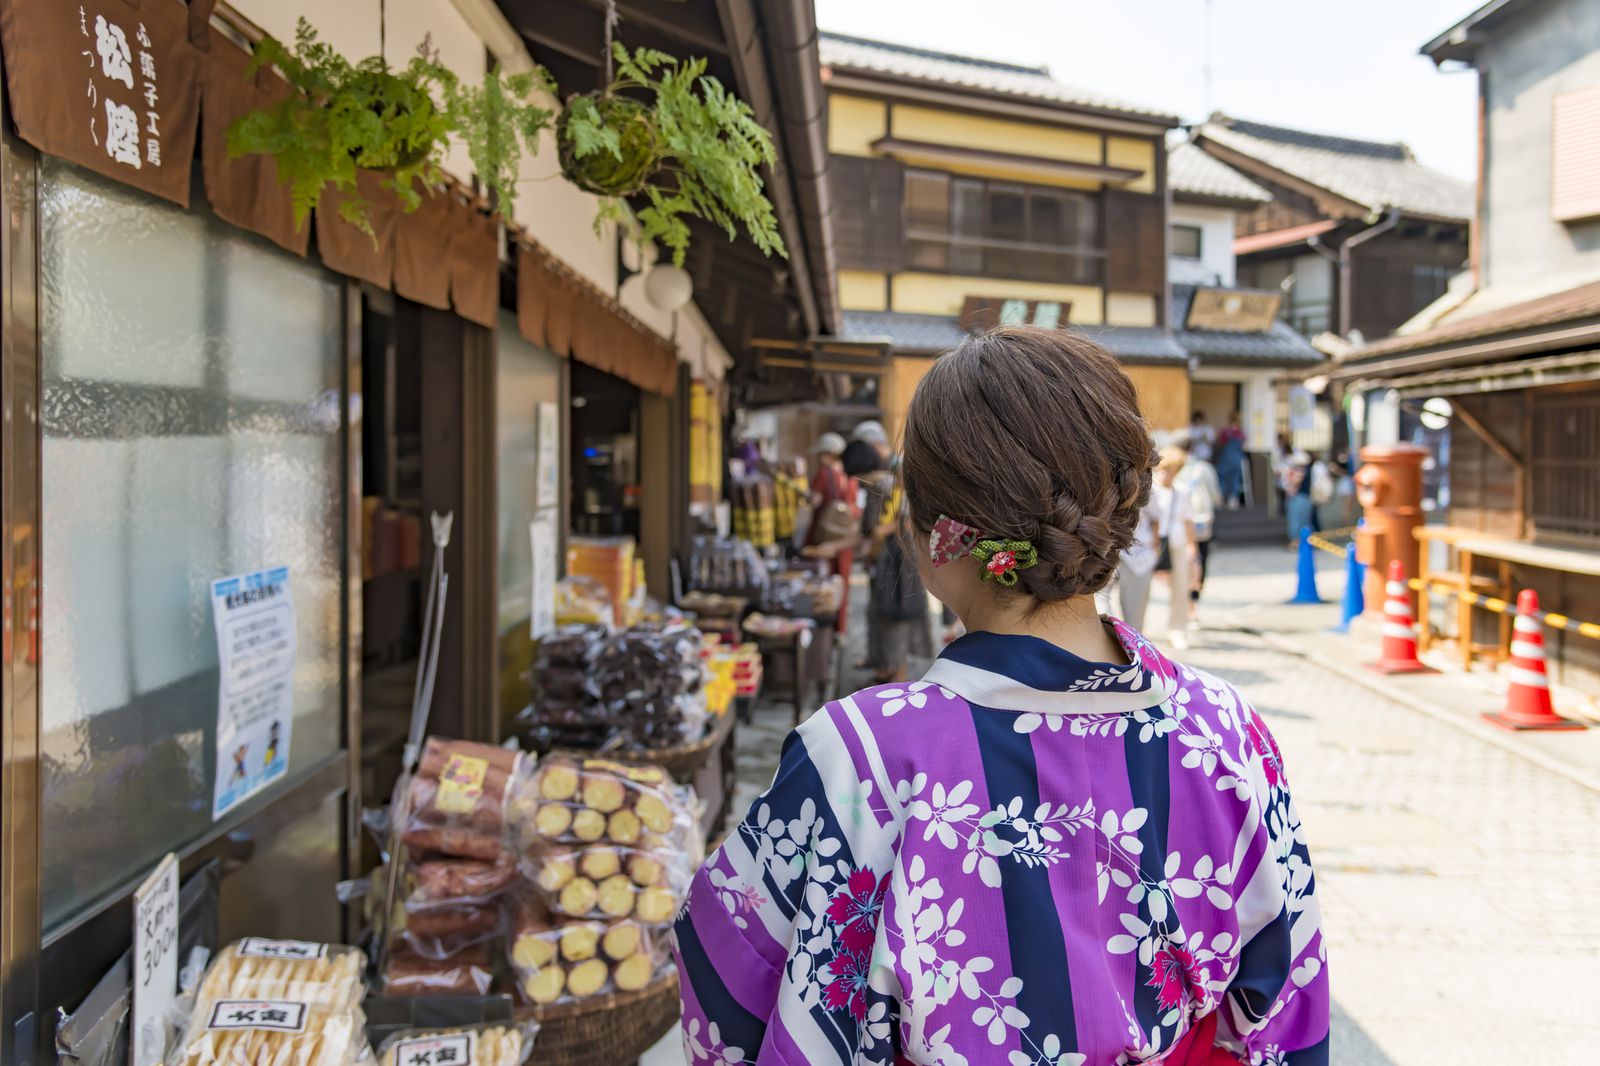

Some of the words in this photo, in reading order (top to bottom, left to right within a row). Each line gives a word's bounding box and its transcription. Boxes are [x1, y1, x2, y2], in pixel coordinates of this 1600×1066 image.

[80, 5, 99, 146] まつりく
[136, 22, 161, 167] ふ菓子工房
